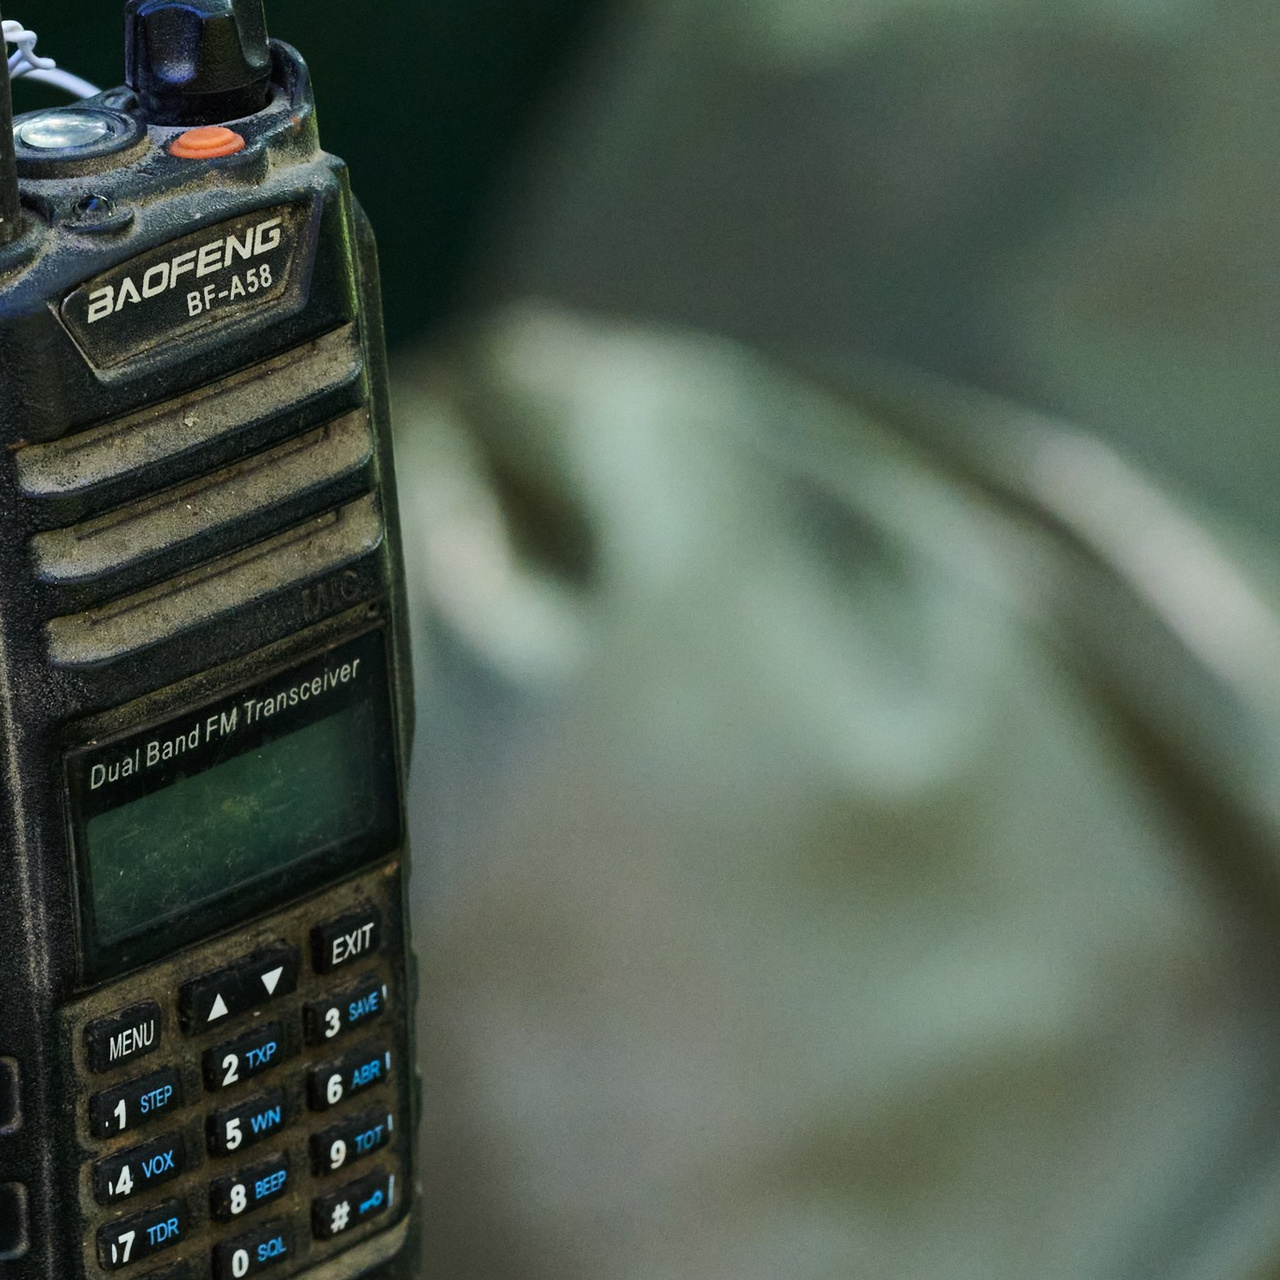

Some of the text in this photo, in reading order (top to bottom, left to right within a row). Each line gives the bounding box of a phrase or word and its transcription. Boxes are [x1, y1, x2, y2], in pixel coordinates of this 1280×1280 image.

[87, 218, 282, 323] BAOFENG
[187, 264, 272, 317] BF-A58
[90, 658, 360, 790] Dual Band FM Transceiver
[332, 922, 374, 965] EXIT
[325, 991, 379, 1038] 3 SAVE
[109, 1020, 154, 1061] MENU
[222, 1041, 277, 1087] 2 TXP
[327, 1060, 381, 1105] 6 ABR
[114, 1085, 173, 1130] 1 STEP
[226, 1118, 242, 1150] 5
[330, 1124, 384, 1170] 9 TOT
[115, 1150, 175, 1195] 4 VOX
[230, 1170, 287, 1214] 8 BEEP
[118, 1218, 179, 1263] 7 TDR
[232, 1236, 287, 1278] 0 SQL
